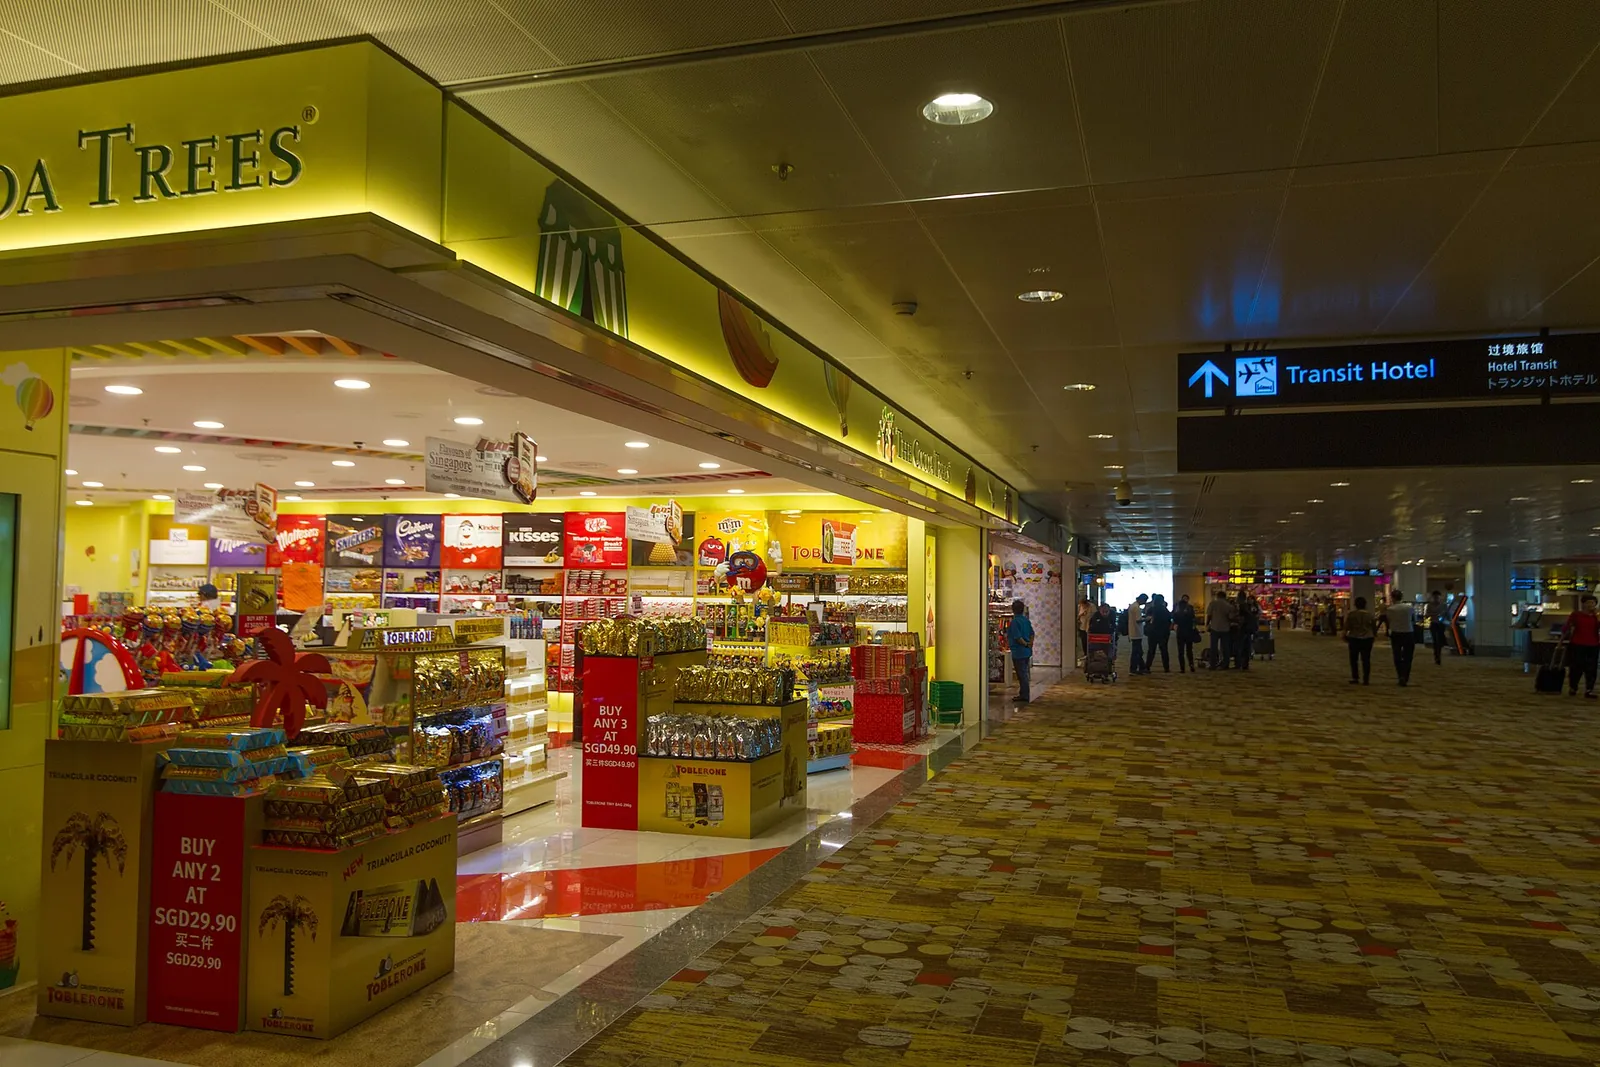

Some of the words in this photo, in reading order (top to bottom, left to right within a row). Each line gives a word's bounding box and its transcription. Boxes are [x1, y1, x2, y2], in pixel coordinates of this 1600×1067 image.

[78, 122, 303, 208] TREES
[1488, 342, 1544, 356] 过境旅馆
[1286, 361, 1363, 385] Transit
[1371, 358, 1436, 381] Hotel
[1488, 360, 1518, 372] Hotel
[1520, 358, 1558, 371] Transit
[1488, 374, 1598, 389] トランジットホテル
[429, 451, 473, 474] Singapore
[398, 520, 434, 538] Cadbury
[276, 528, 320, 552] Maltesers
[336, 528, 377, 551] SNICKERS
[791, 545, 885, 561] TOBONE
[736, 578, 752, 590] m
[387, 630, 436, 645] TOBLERONE
[599, 705, 623, 717] BUY
[593, 717, 618, 729] ANY
[621, 718, 628, 730] 3
[603, 731, 618, 742] AT
[584, 742, 637, 756] SGD49.90
[676, 764, 727, 776] TOBLERONE
[180, 836, 216, 857] BUY
[342, 854, 365, 882] NEW
[366, 847, 414, 872] TRIANGULAR
[172, 860, 207, 881] ANY
[210, 864, 221, 882] 2
[185, 886, 207, 905] AT
[154, 907, 236, 932] SGD29.90
[175, 932, 214, 950] 买二件
[166, 951, 222, 970] SGD29.90
[366, 958, 426, 1002] TOBLERONE
[46, 986, 126, 1010] TOBLERONE
